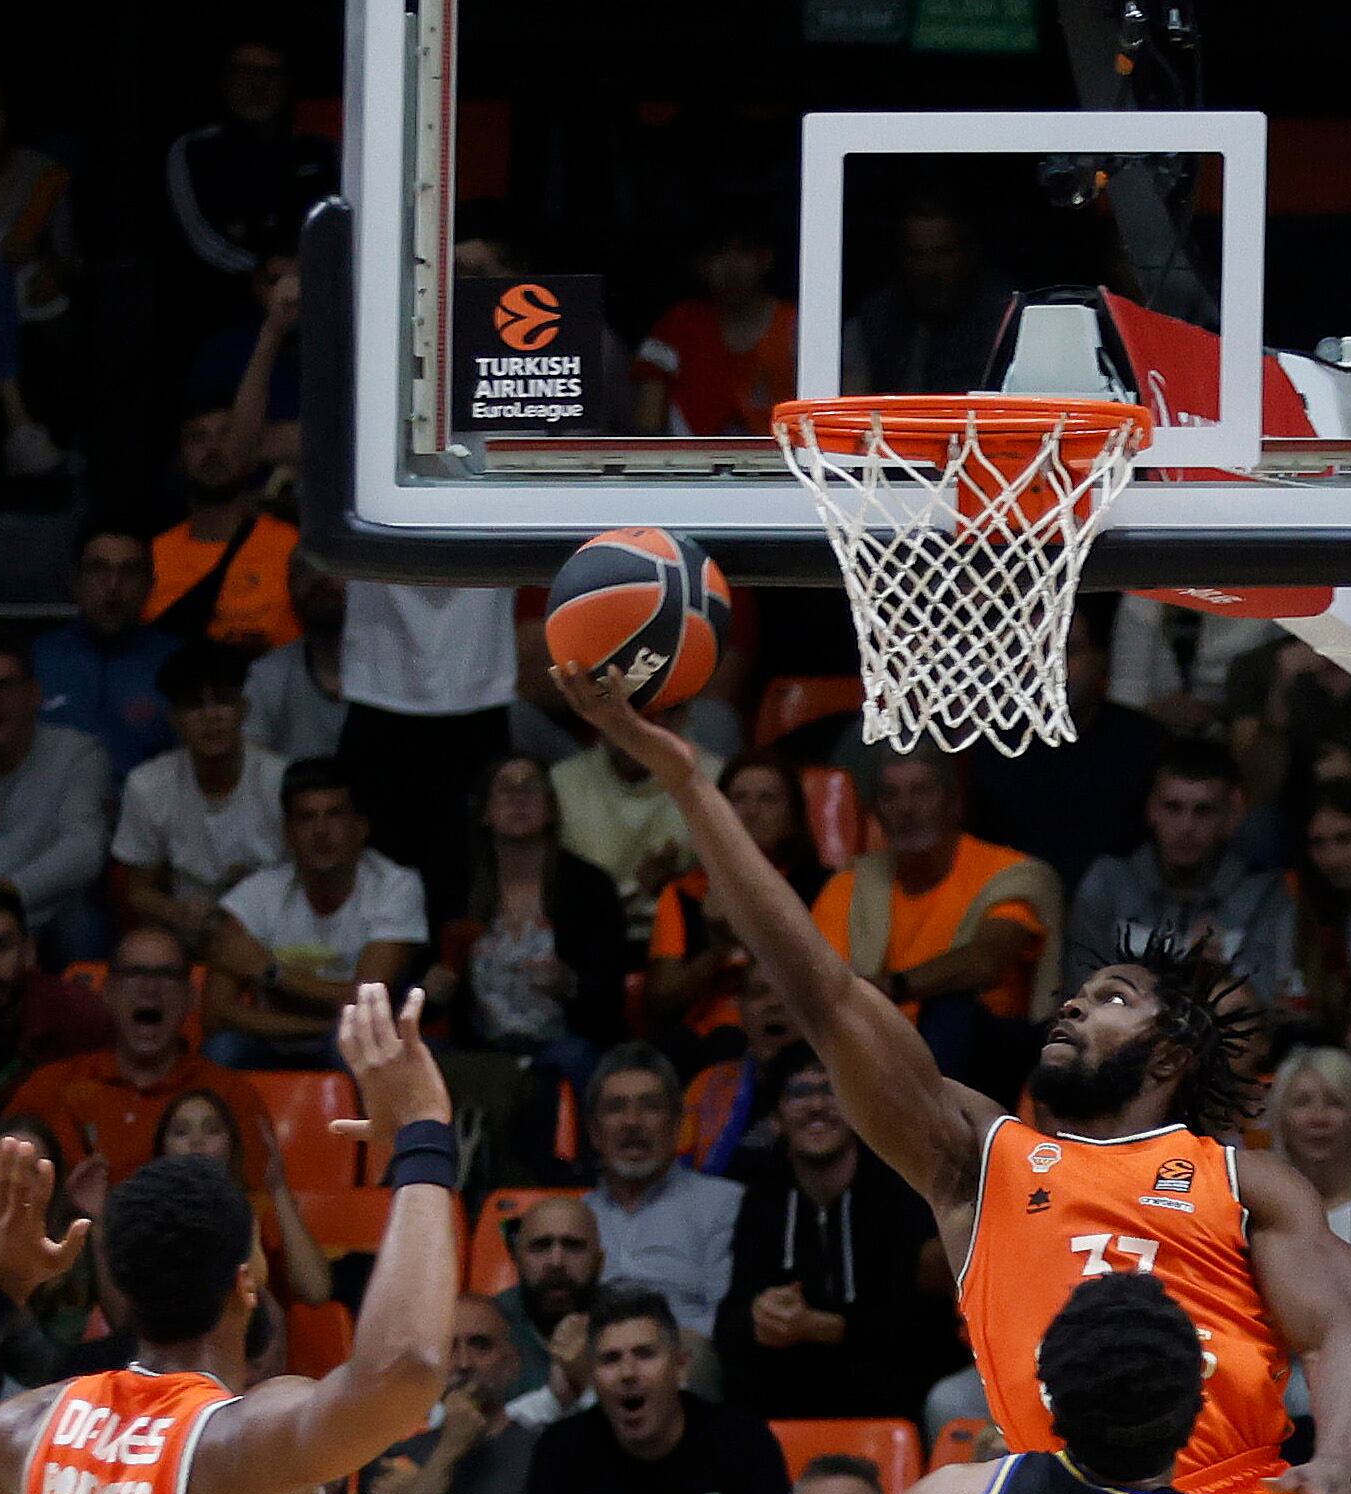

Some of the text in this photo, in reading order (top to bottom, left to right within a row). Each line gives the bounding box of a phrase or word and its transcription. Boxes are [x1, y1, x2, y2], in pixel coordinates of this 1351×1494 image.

[475, 356, 582, 377] TURKISH
[473, 378, 583, 398] AIRLINES
[472, 401, 584, 423] EuroLeague
